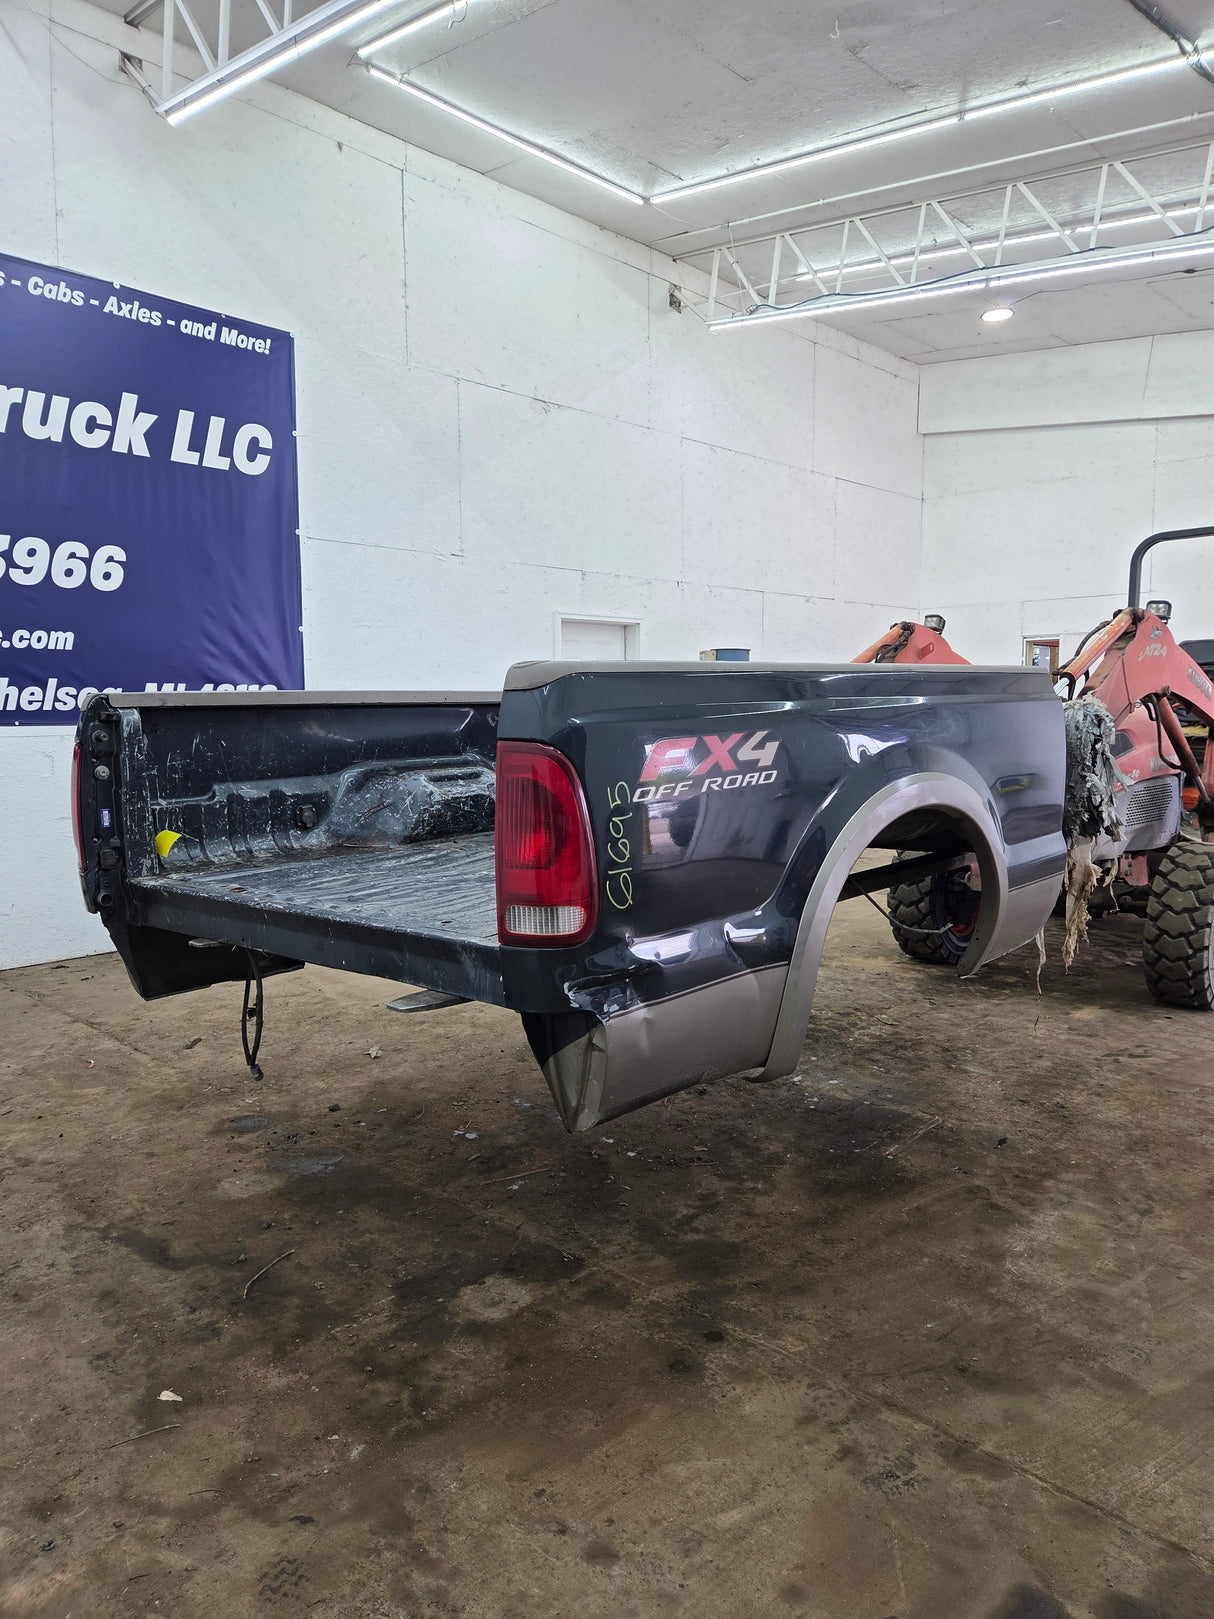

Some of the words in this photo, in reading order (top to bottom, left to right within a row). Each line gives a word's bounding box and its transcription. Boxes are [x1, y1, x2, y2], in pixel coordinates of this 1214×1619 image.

[27, 276, 85, 306] Cabs
[103, 296, 162, 326] Axles
[180, 319, 216, 341] and
[220, 326, 271, 355] More!
[170, 409, 273, 476] LLC
[0, 534, 126, 592] 966
[0, 629, 75, 651] .com
[639, 730, 779, 782] FX4
[633, 781, 692, 803] OFF
[701, 770, 777, 793] ROAD
[606, 781, 633, 909] 61695
